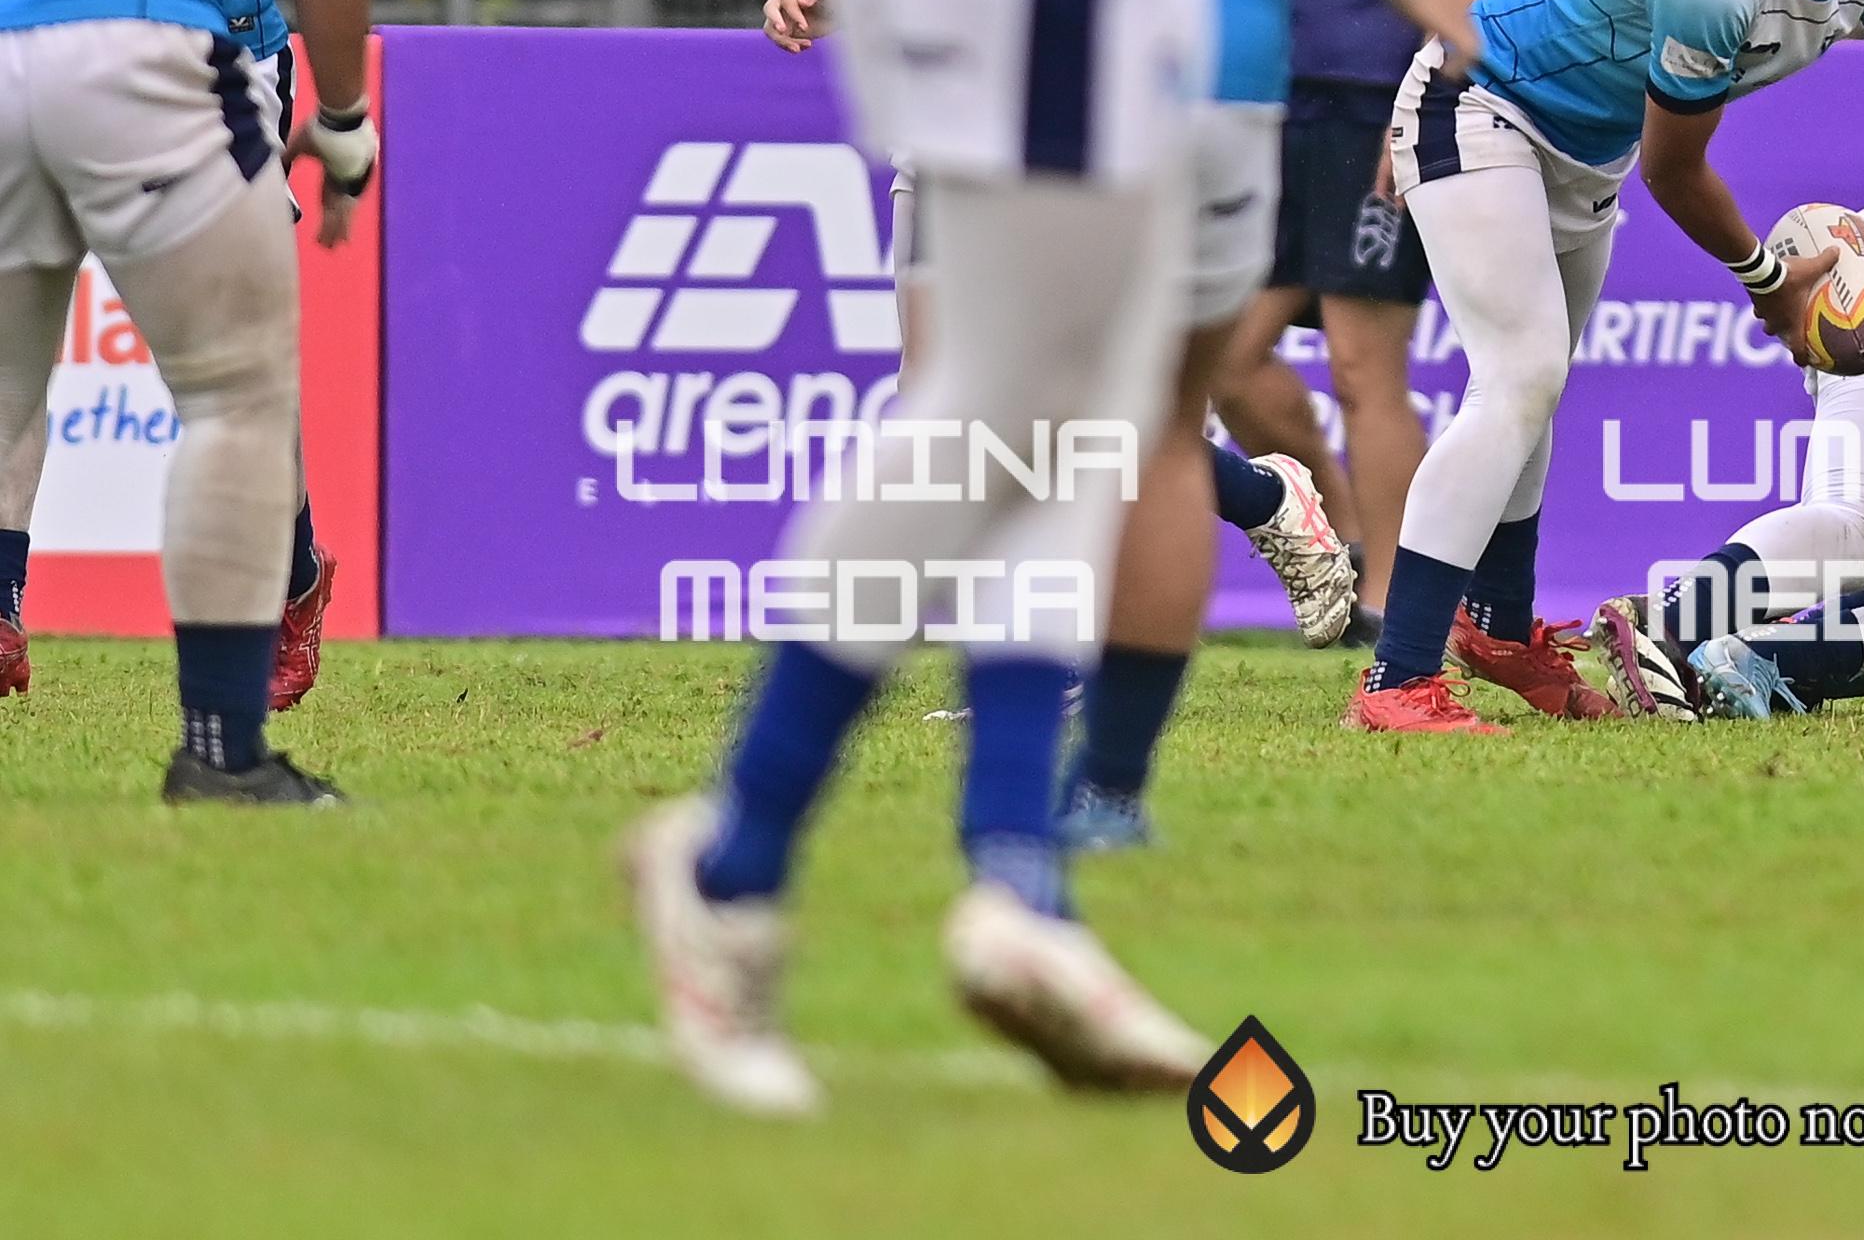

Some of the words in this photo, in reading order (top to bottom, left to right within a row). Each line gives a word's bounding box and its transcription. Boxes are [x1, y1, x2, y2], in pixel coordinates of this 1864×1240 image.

[55, 266, 152, 366] la
[1573, 299, 1799, 366] RTIFIC
[47, 383, 184, 446] ethe
